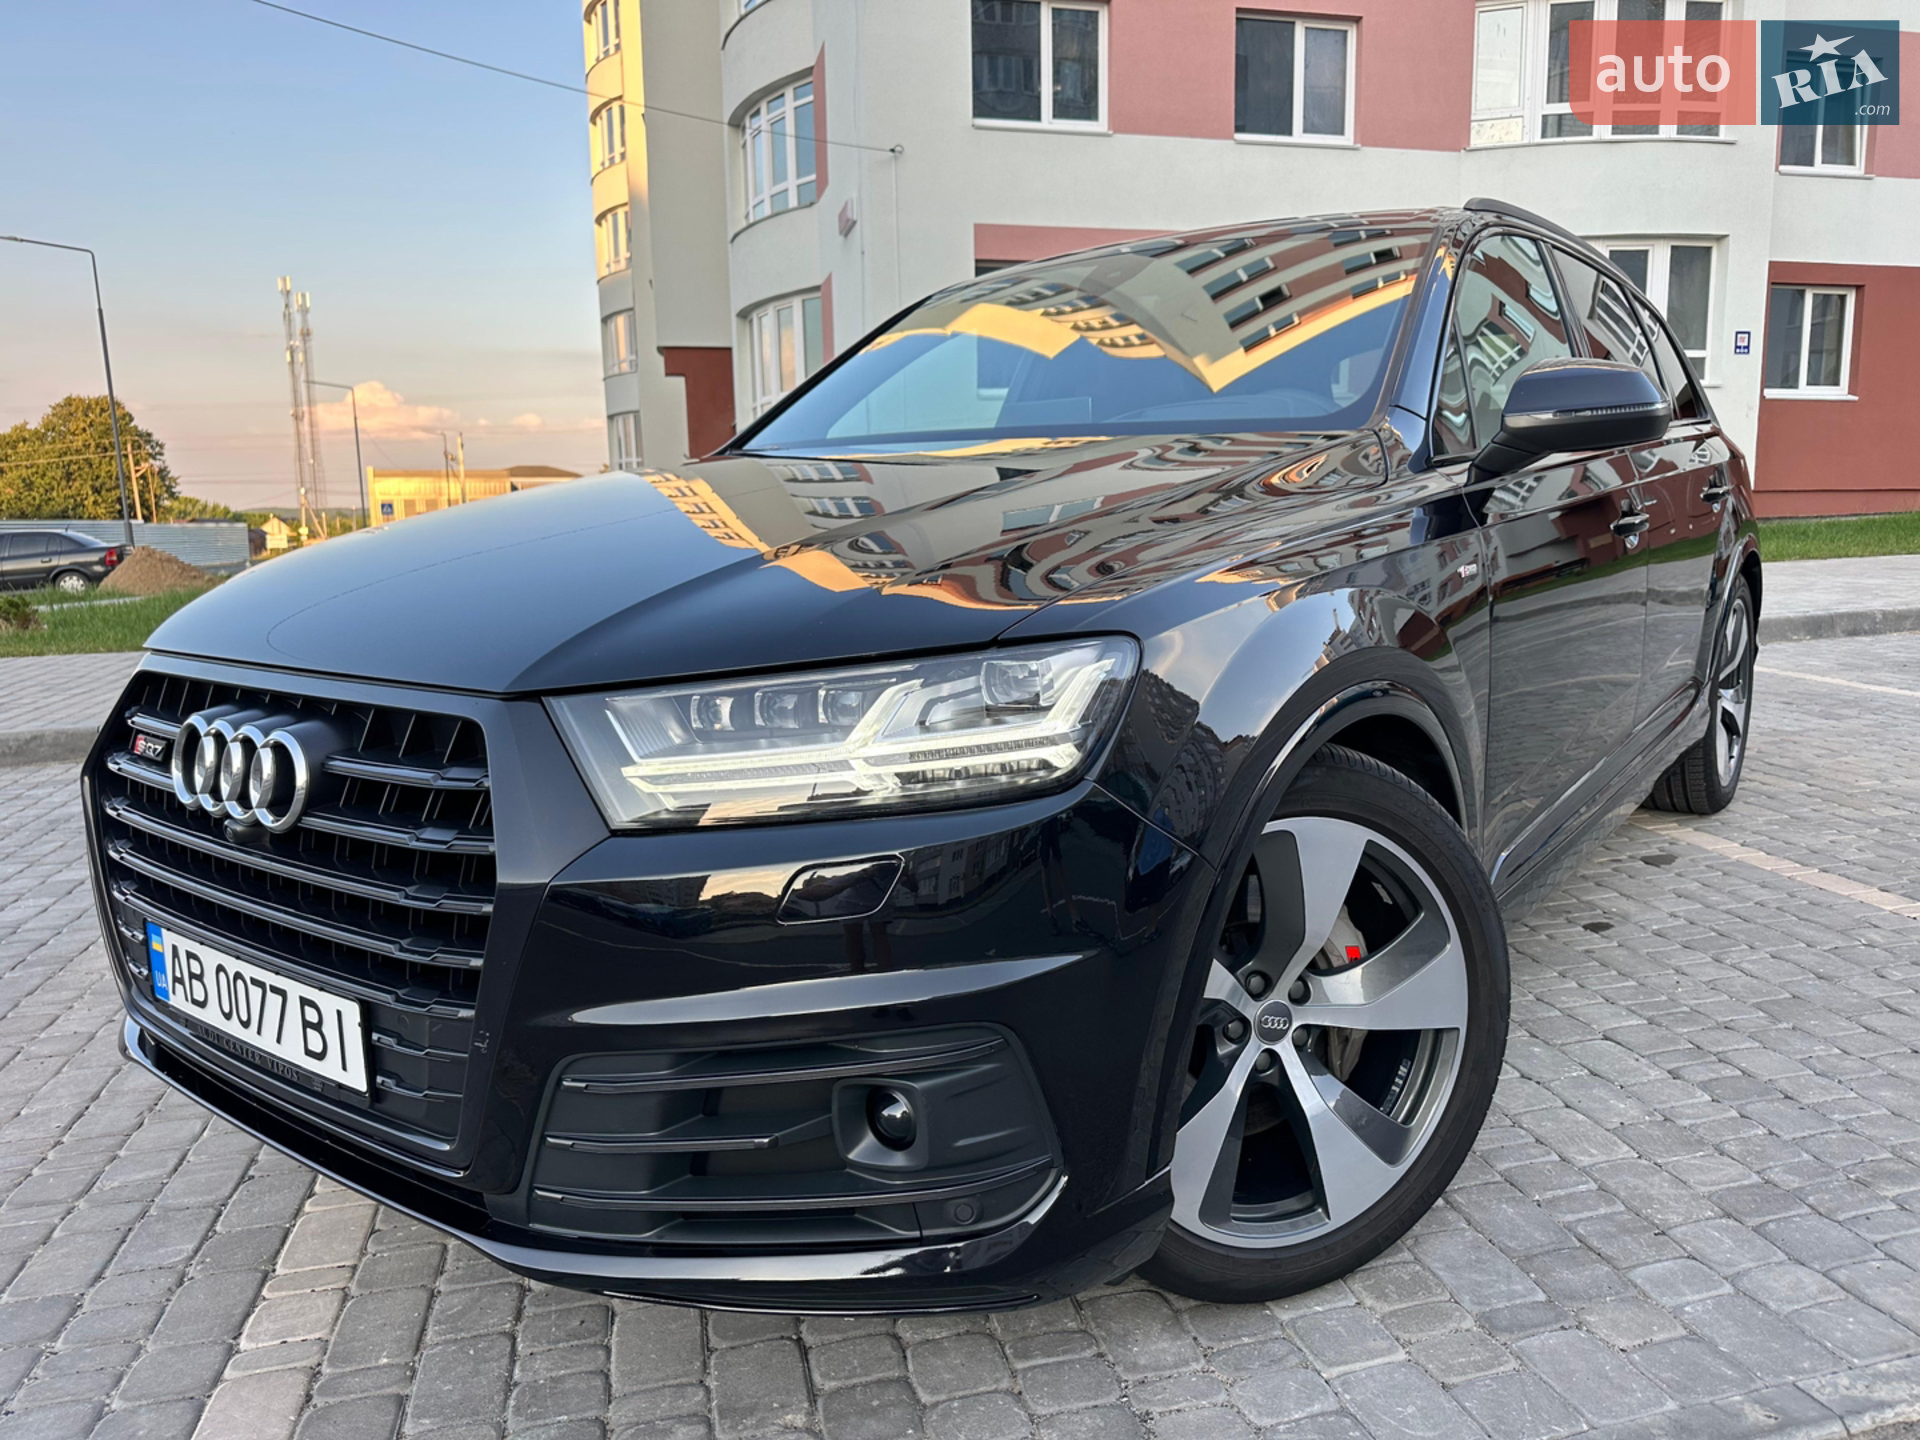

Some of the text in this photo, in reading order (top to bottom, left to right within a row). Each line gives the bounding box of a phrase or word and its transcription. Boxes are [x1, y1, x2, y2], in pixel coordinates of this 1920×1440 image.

[137, 739, 163, 757] SQ7
[155, 969, 169, 991] UA
[171, 943, 348, 1073] AB 0077 BI
